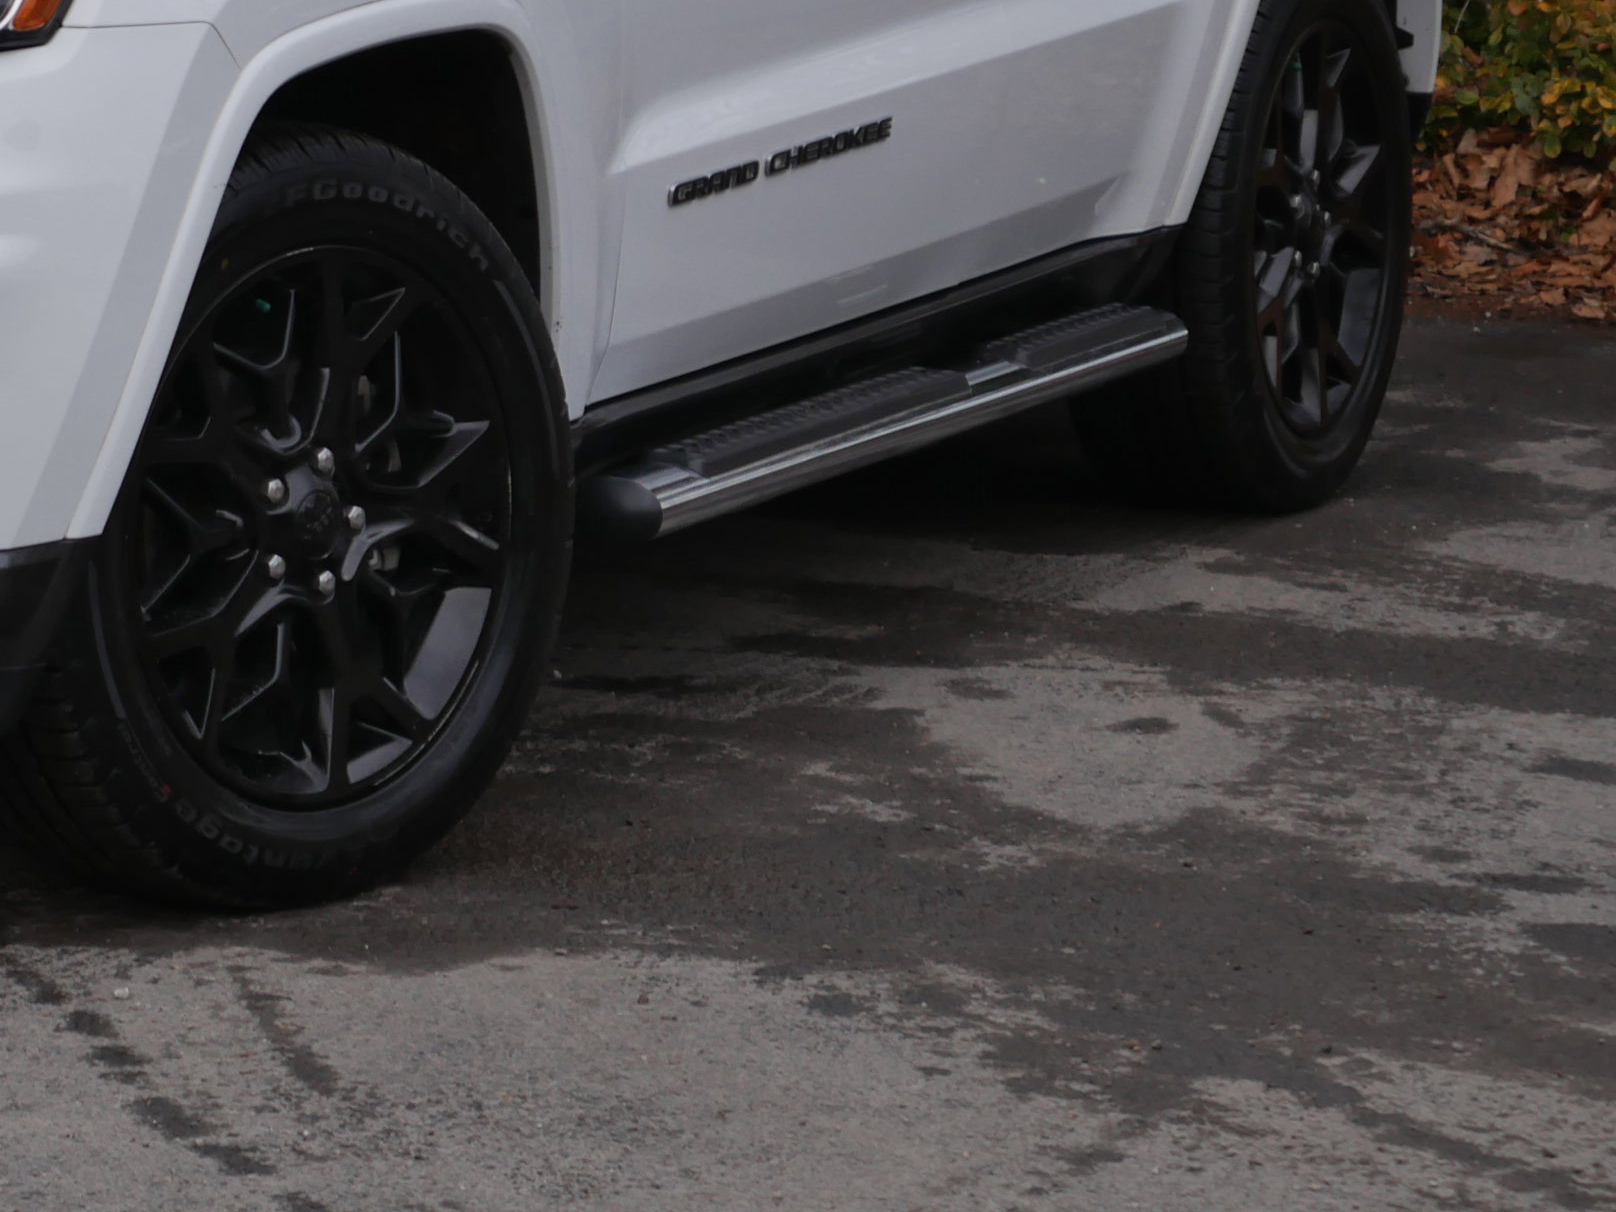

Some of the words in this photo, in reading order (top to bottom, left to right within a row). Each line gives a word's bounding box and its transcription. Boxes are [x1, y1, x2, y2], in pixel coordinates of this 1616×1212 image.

[668, 159, 760, 207] GRAND
[764, 117, 893, 176] CHEROKEE
[277, 179, 490, 272] FGoodrich
